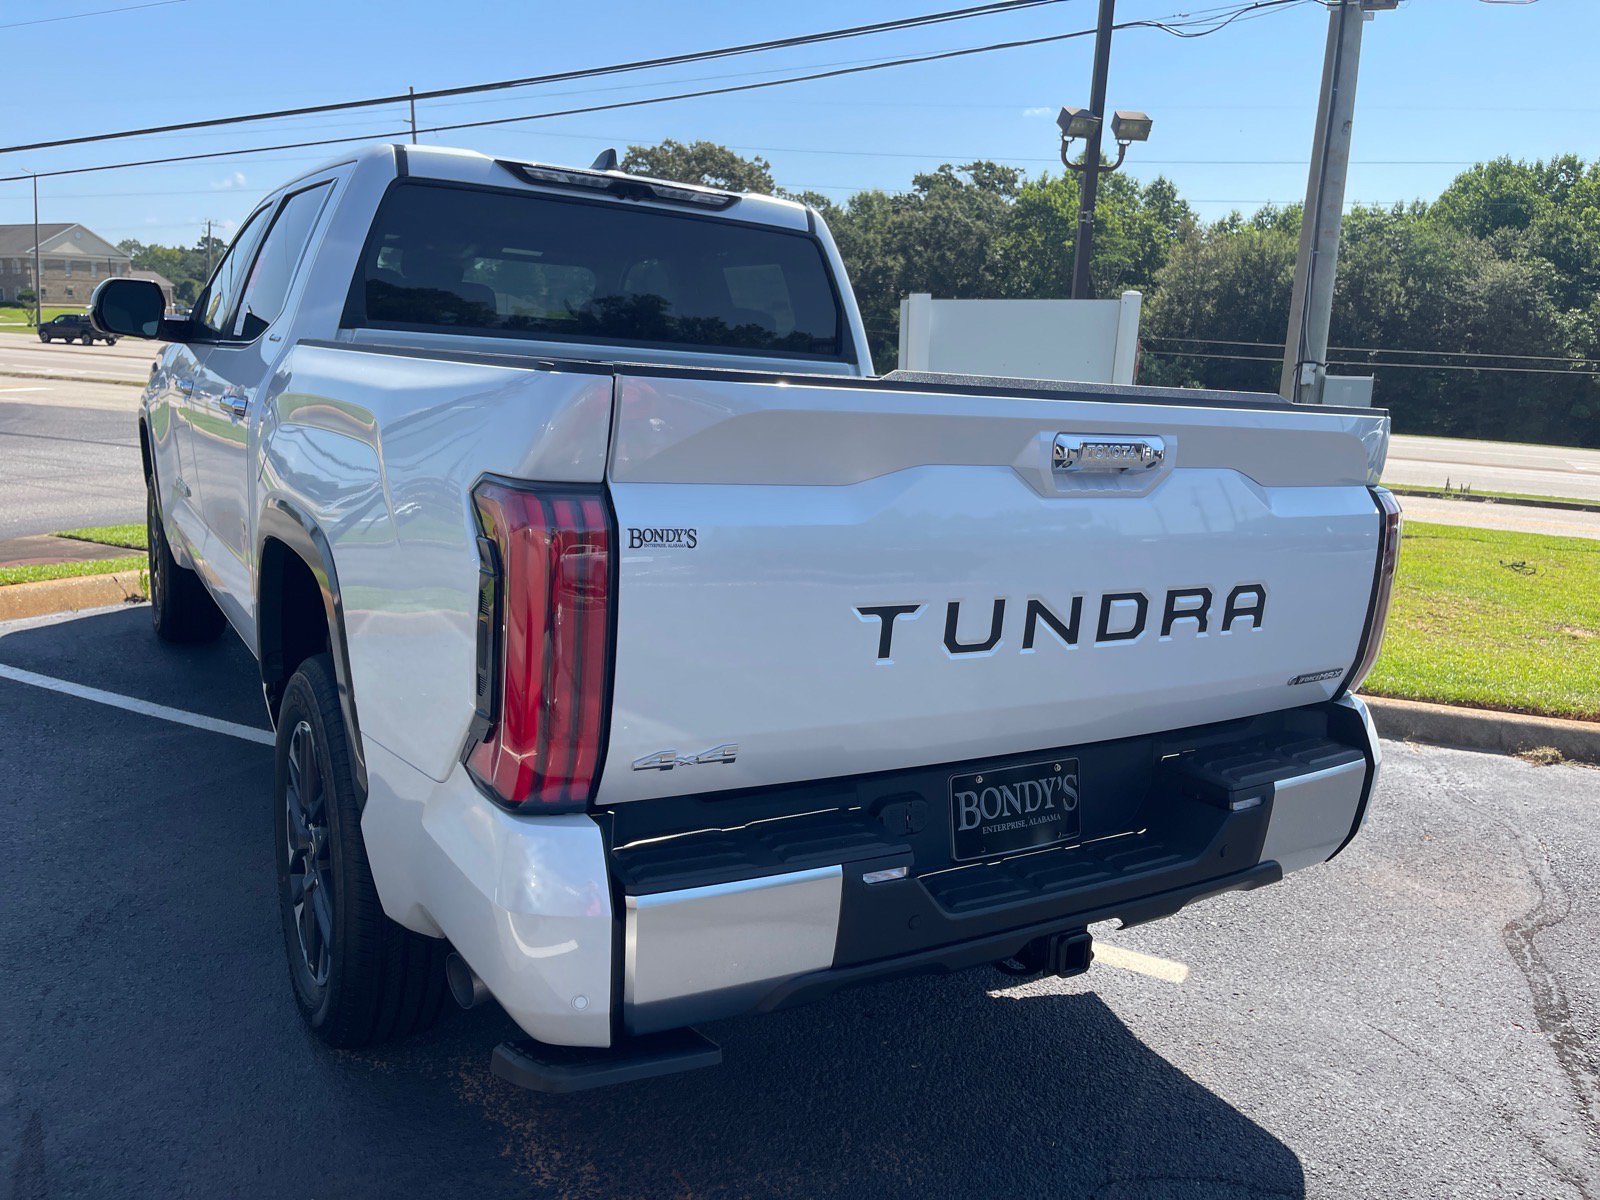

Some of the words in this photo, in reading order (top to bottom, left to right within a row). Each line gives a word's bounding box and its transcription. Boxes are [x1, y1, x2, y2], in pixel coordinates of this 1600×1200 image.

[1087, 445, 1137, 459] TOYOTA
[627, 528, 697, 548] BONDY'S
[852, 583, 1267, 665] TUNDRA
[954, 774, 1078, 831] BONDY'S
[982, 820, 1028, 834] ENTERPRISE,
[1029, 813, 1061, 826] ALABAMA
